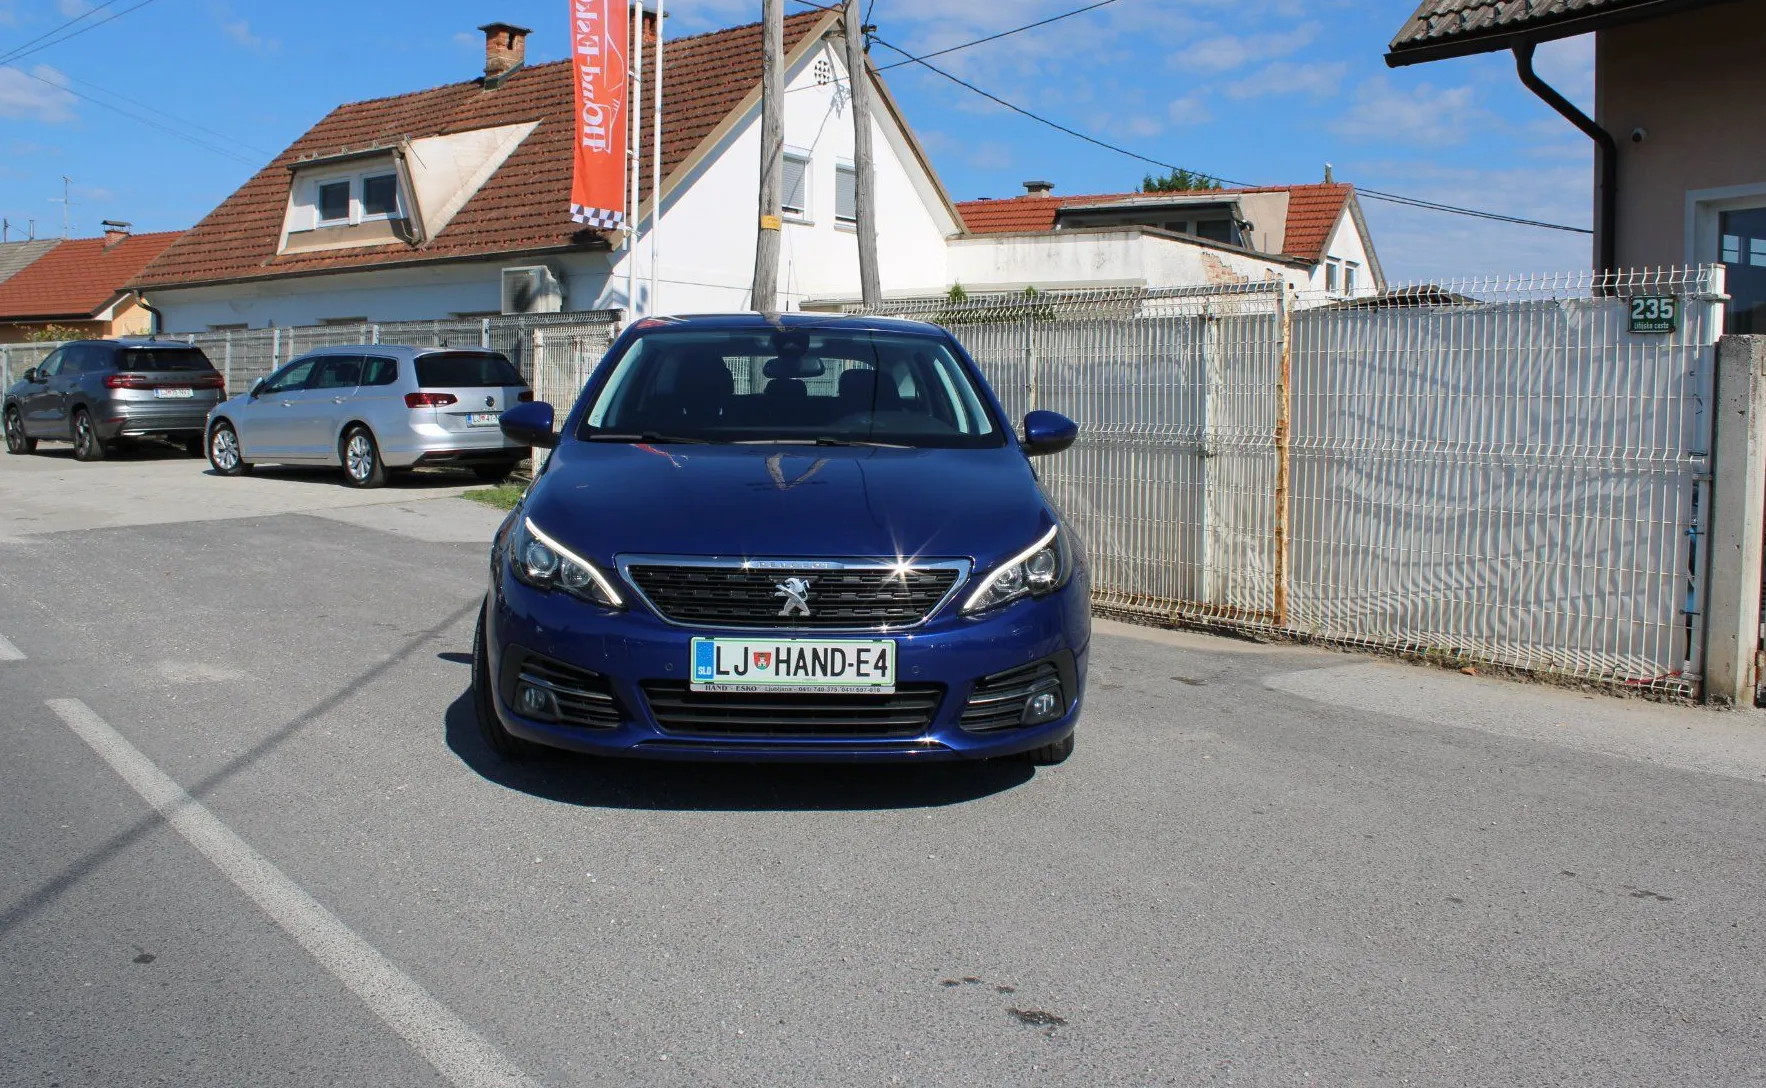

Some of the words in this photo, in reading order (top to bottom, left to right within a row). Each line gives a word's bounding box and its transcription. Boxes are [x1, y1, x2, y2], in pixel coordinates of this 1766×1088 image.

[1632, 299, 1674, 319] 235
[698, 667, 712, 675] SLO
[715, 646, 749, 676] LJ
[774, 646, 888, 677] HAND-E4
